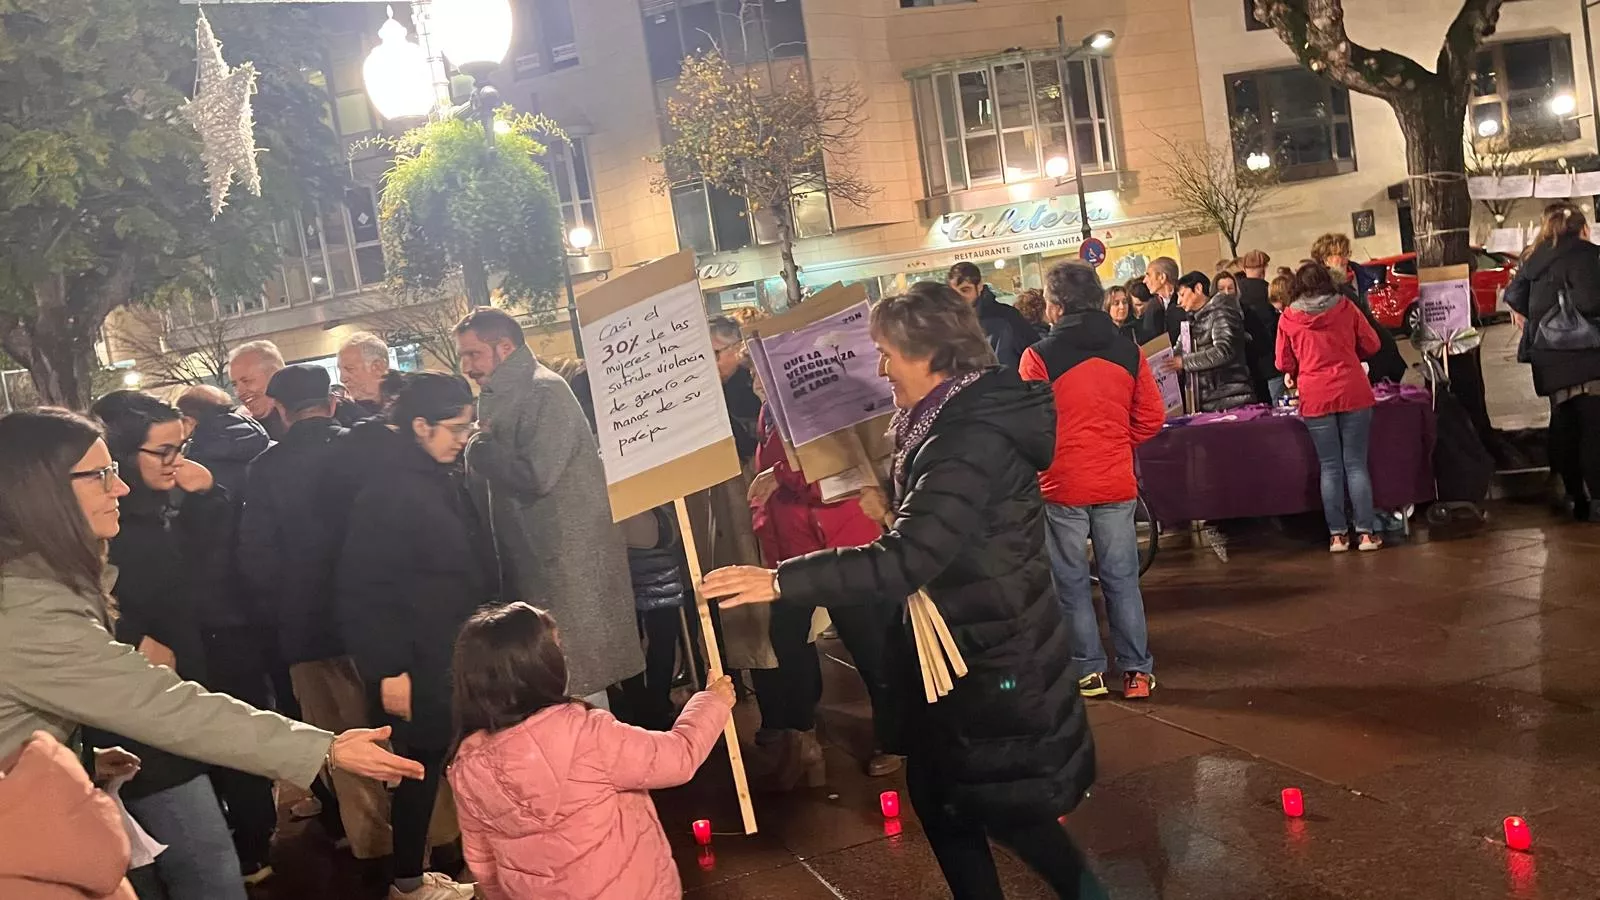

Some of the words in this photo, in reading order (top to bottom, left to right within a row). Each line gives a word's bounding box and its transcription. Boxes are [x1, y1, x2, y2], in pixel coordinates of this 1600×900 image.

[954, 247, 1012, 261] RESTAURANTE
[1057, 236, 1081, 246] ANITA
[695, 262, 738, 280] ar
[599, 317, 632, 341] Casi
[644, 305, 659, 321] el
[602, 334, 640, 364] 30%
[646, 328, 666, 344] de
[671, 320, 689, 331] las
[606, 351, 651, 377] mujeres
[658, 343, 681, 355] ha
[609, 367, 652, 394] sufrido
[657, 353, 705, 373] violencia
[784, 355, 806, 370] QUE
[807, 350, 822, 360] LA
[609, 397, 629, 414] de
[684, 374, 700, 383] a
[809, 374, 839, 391] LADO
[613, 410, 649, 431] manos
[656, 397, 679, 413] de
[683, 391, 700, 403] su
[619, 424, 668, 456] pareja
